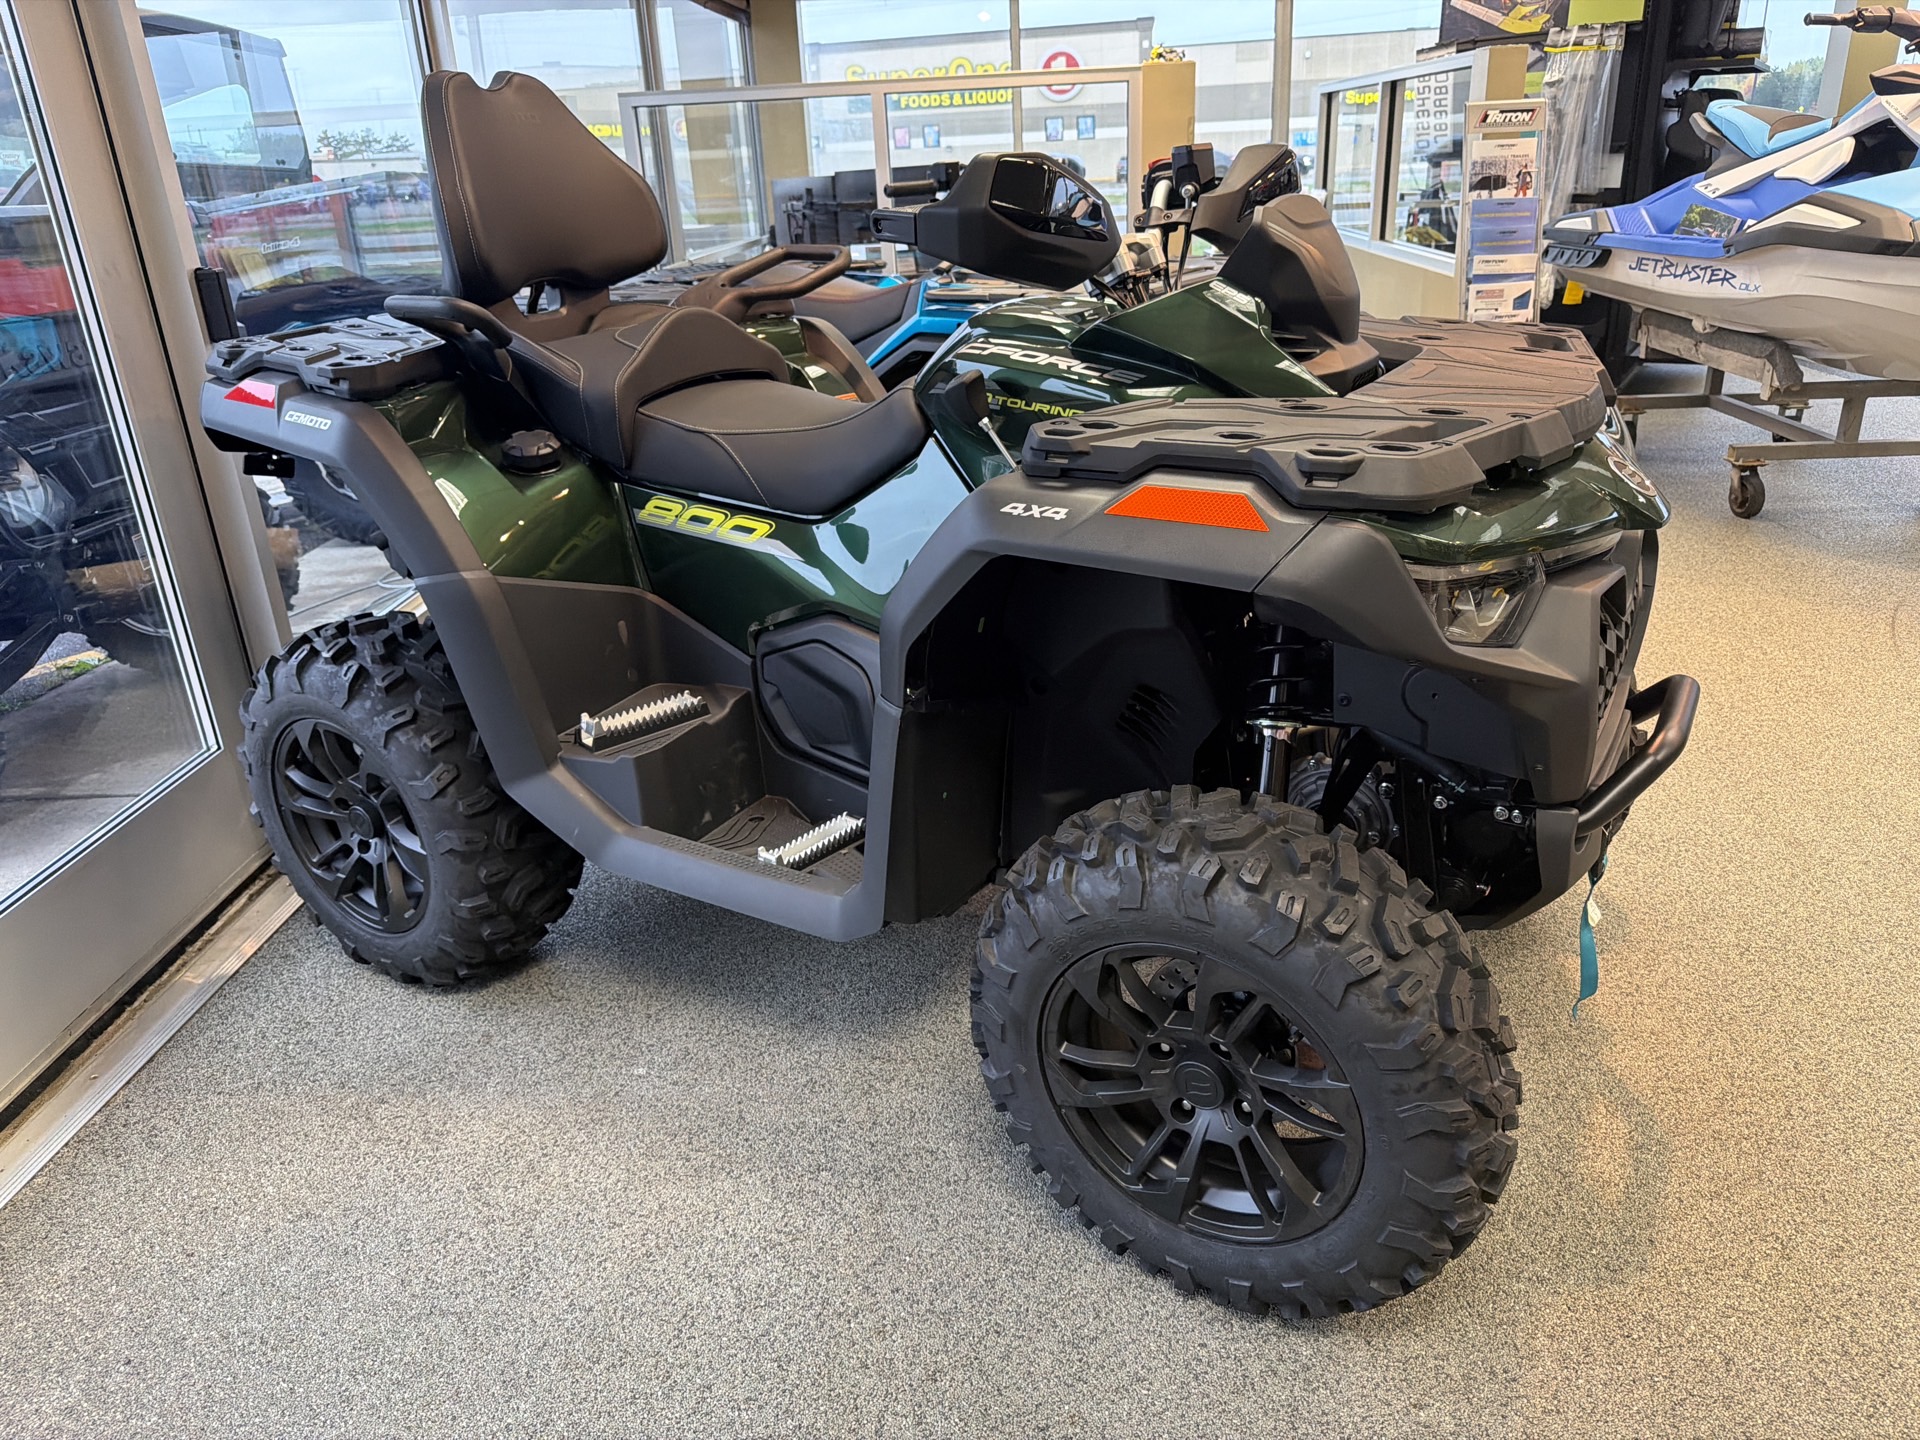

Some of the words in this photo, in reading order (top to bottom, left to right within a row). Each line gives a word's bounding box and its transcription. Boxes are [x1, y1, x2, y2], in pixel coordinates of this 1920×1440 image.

[900, 93, 950, 108] FOODS
[952, 92, 963, 105] &
[1484, 109, 1533, 123] TRITON
[1738, 281, 1761, 292] DLX
[957, 342, 1147, 384] CFORCE
[284, 410, 332, 431] CFMOTO
[638, 495, 776, 544] 800
